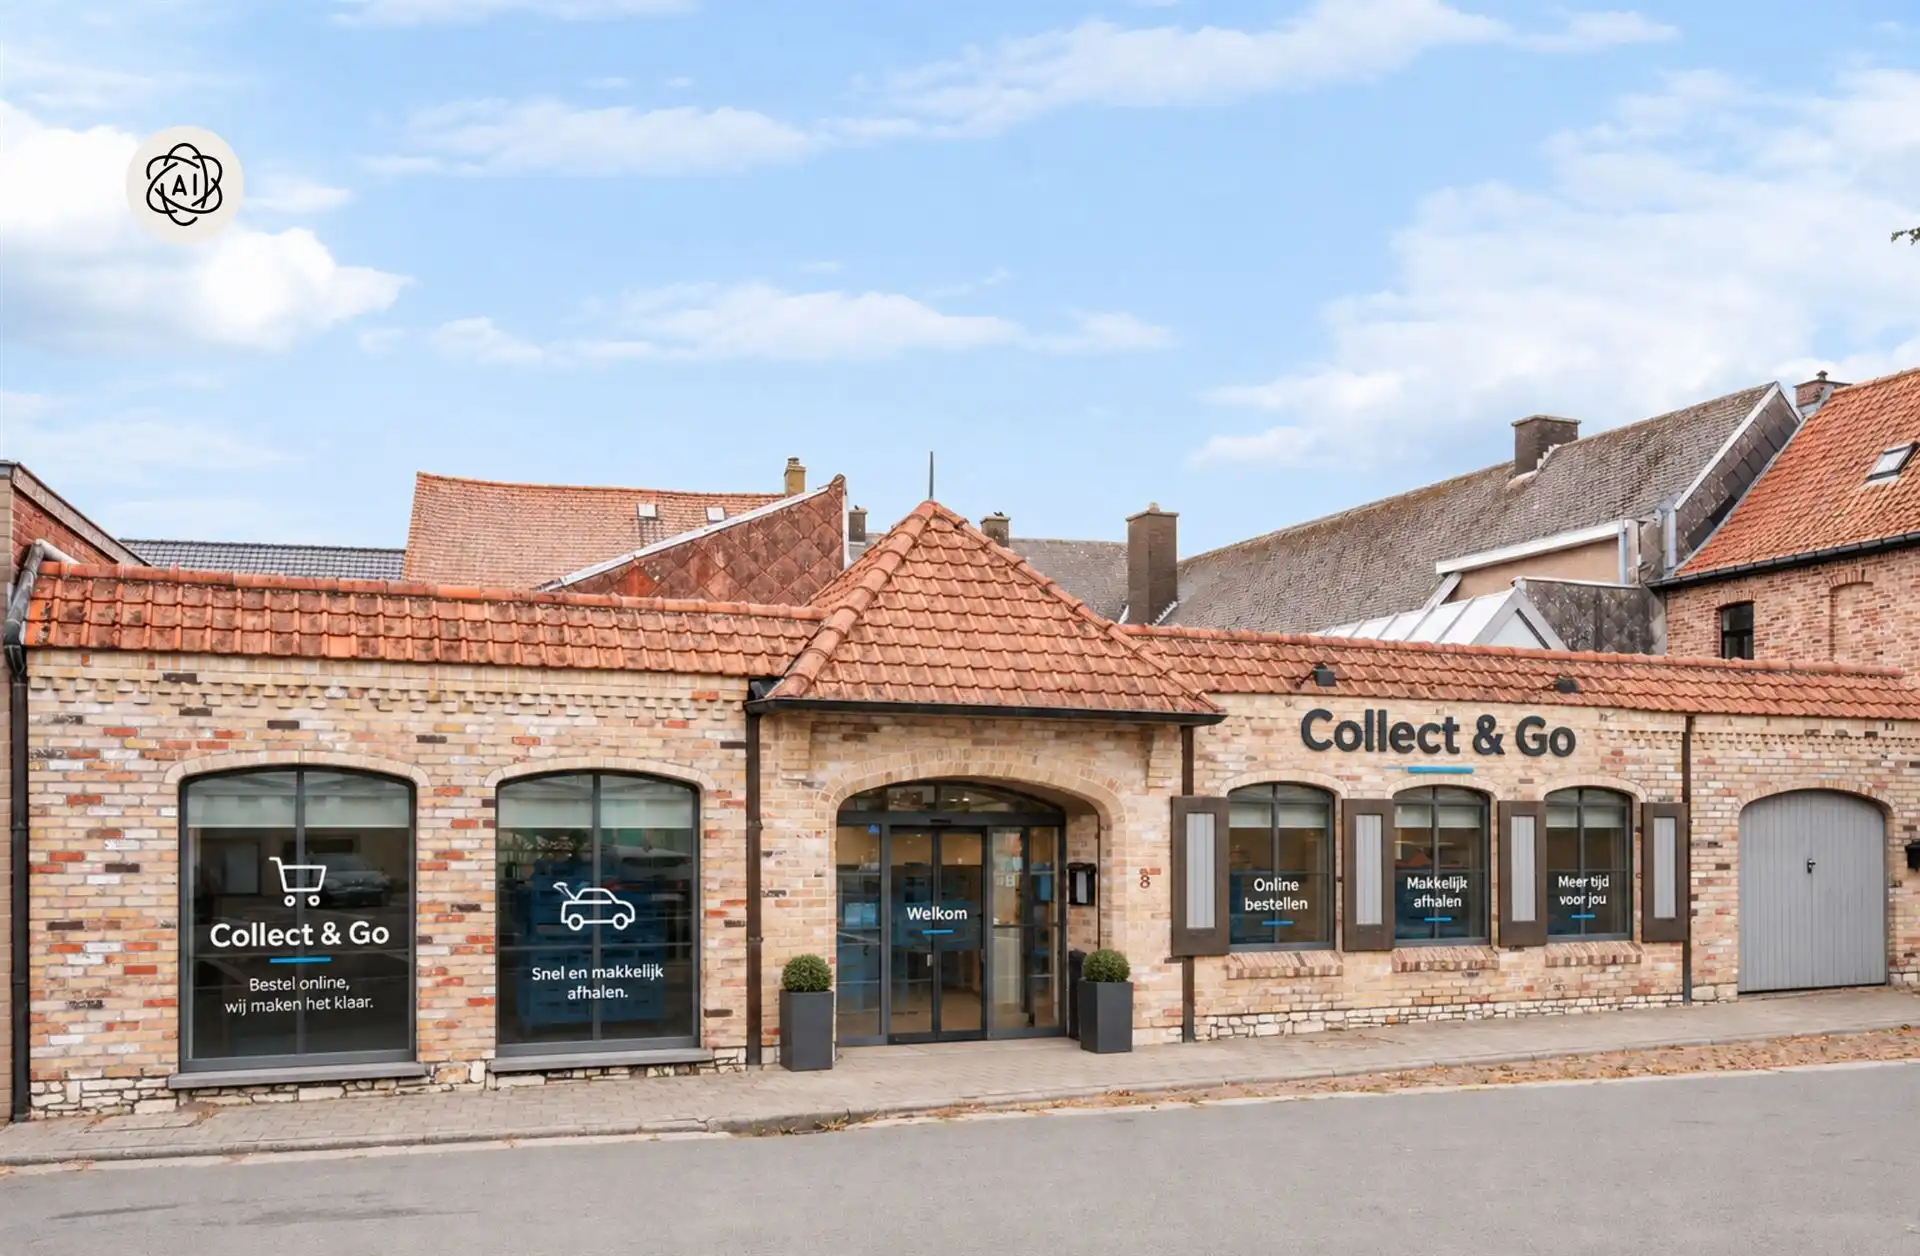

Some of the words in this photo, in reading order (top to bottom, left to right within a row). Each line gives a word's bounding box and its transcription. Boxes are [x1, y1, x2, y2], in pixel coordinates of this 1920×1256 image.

[1301, 708, 1461, 754] Collect
[1472, 714, 1506, 756] &
[1515, 715, 1577, 758] Go
[1253, 877, 1300, 892] Online
[1407, 876, 1468, 893] Makkelijk
[1558, 875, 1589, 888] Meer
[1590, 874, 1610, 891] tijd
[1244, 896, 1308, 911] bestellen
[1413, 894, 1462, 908] afhalen
[1559, 895, 1586, 906] voor
[1587, 891, 1607, 909] jou
[906, 905, 968, 920] Welkom
[210, 922, 314, 947] Collect
[321, 921, 342, 946] &
[349, 920, 390, 945] Go
[532, 965, 565, 981] Snel
[568, 969, 588, 979] en
[592, 963, 664, 981] makkelijk
[249, 976, 296, 992] Bestel
[299, 975, 350, 991] online,
[567, 984, 629, 1000] afhalen.
[225, 998, 247, 1016] wij
[250, 998, 302, 1013] maken
[306, 996, 331, 1011] het
[334, 995, 374, 1009] klaar.
